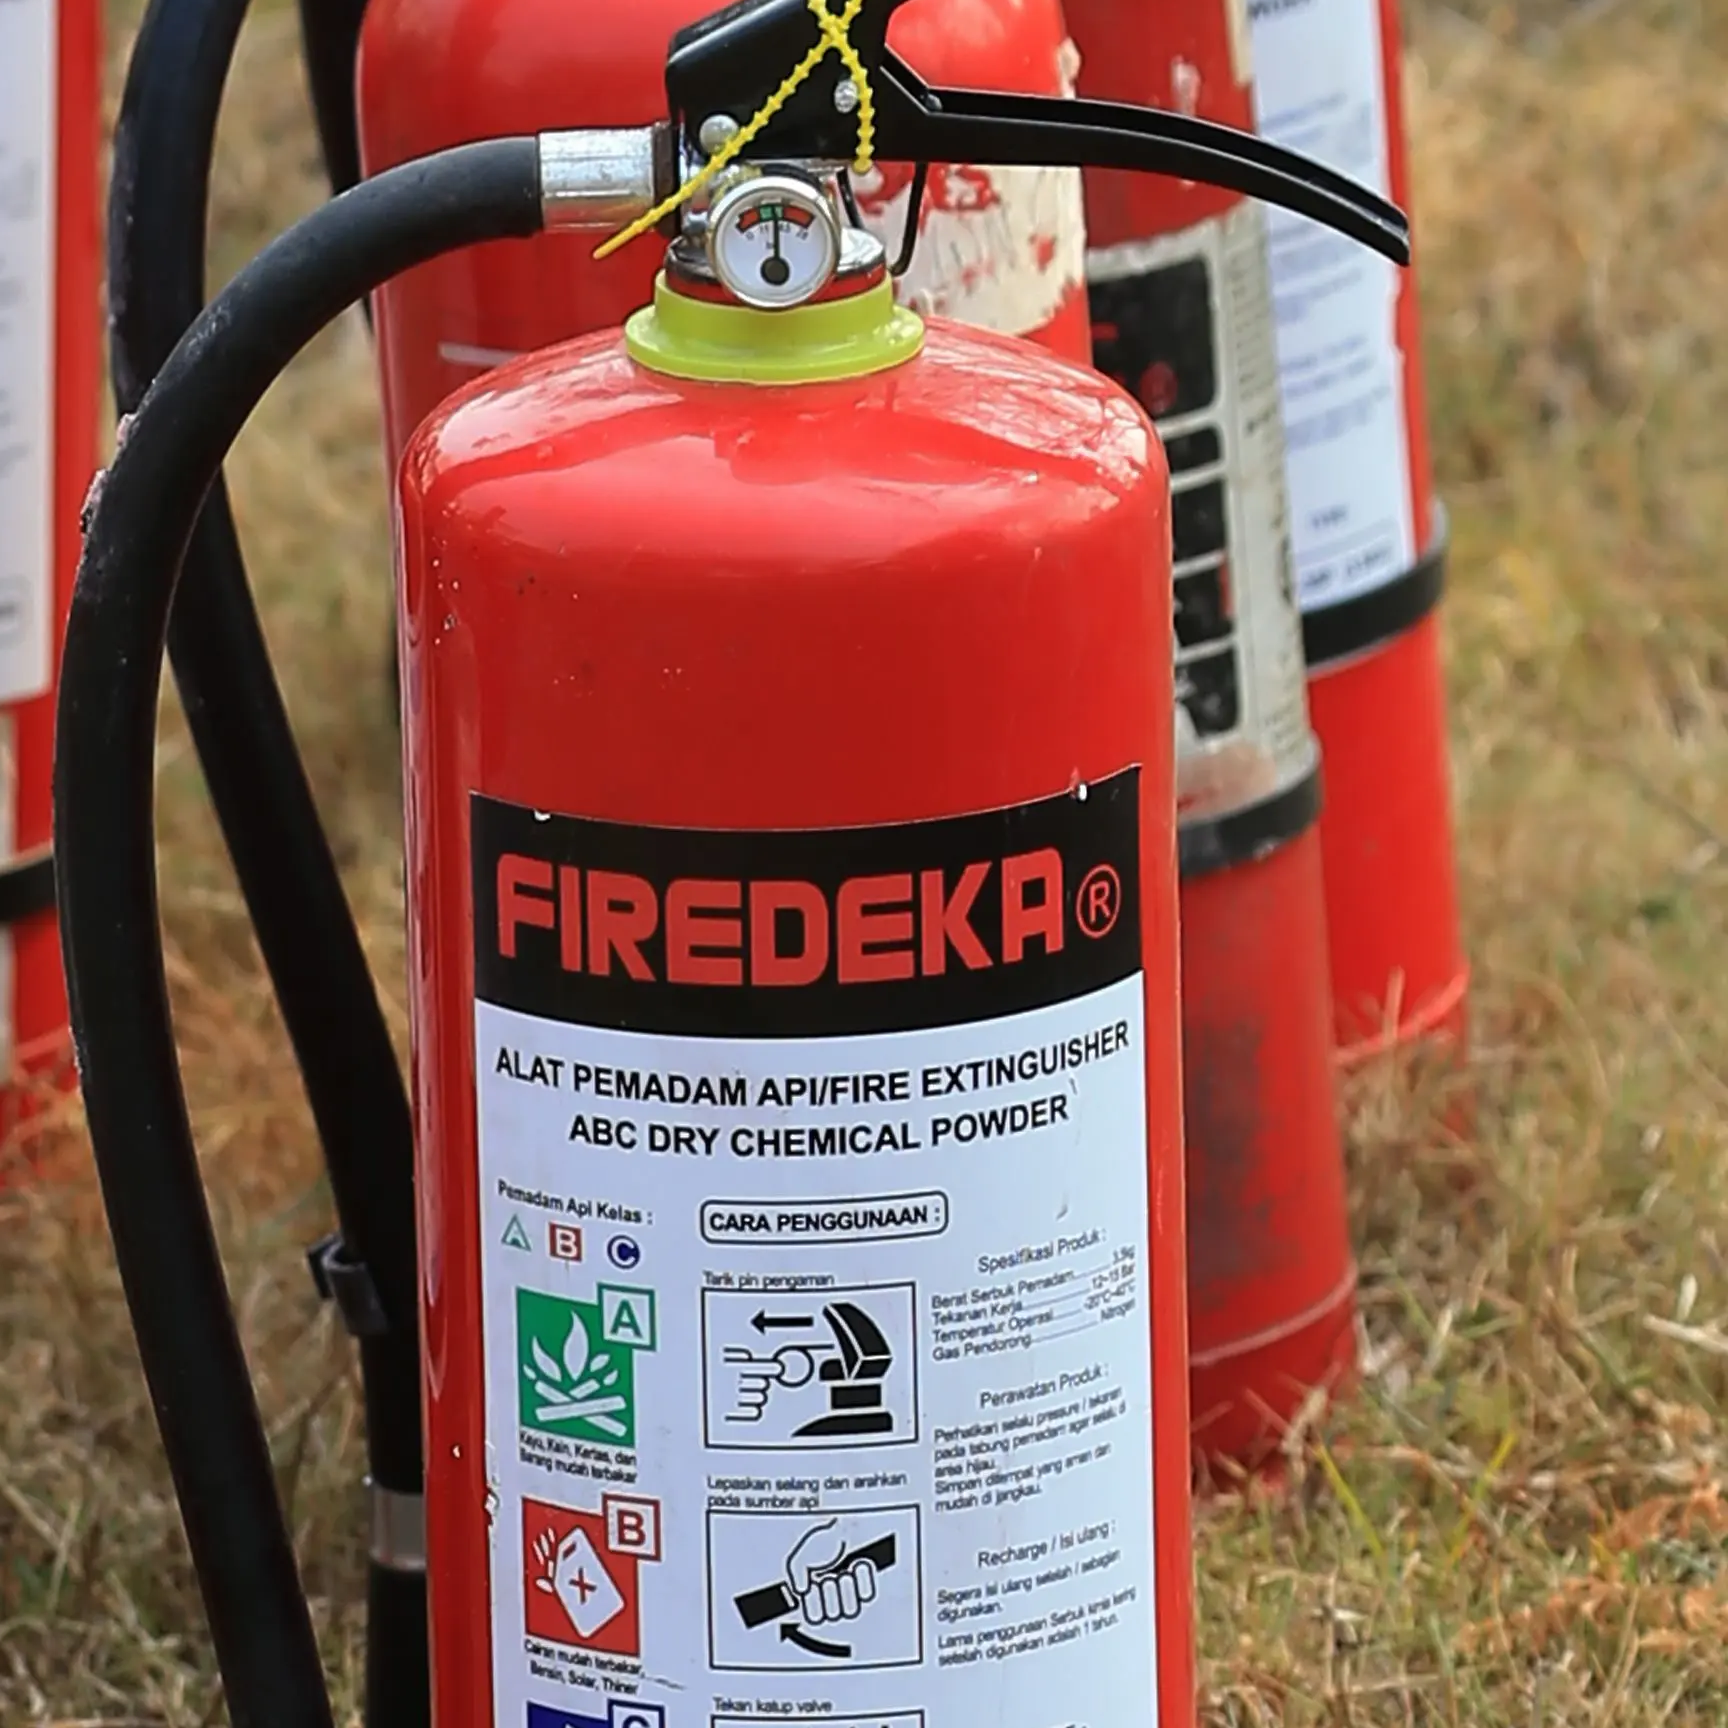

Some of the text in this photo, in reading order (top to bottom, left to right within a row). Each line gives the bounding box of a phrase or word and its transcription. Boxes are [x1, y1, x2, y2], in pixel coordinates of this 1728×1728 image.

[496, 846, 1065, 987] FIREDEKA
[495, 1019, 1130, 1108] ALAT PEMADAM API/FIRE EXTINGUISHER
[568, 1094, 1069, 1158] ABC DRY CHEMICAL POWDER
[498, 1179, 642, 1224] Pemadam Api Kelas
[709, 1204, 929, 1233] CARA PENGGUNAAN
[737, 1272, 760, 1289] pin
[609, 1299, 643, 1339] A
[615, 1509, 647, 1547] B
[977, 1540, 1049, 1569] Recharge
